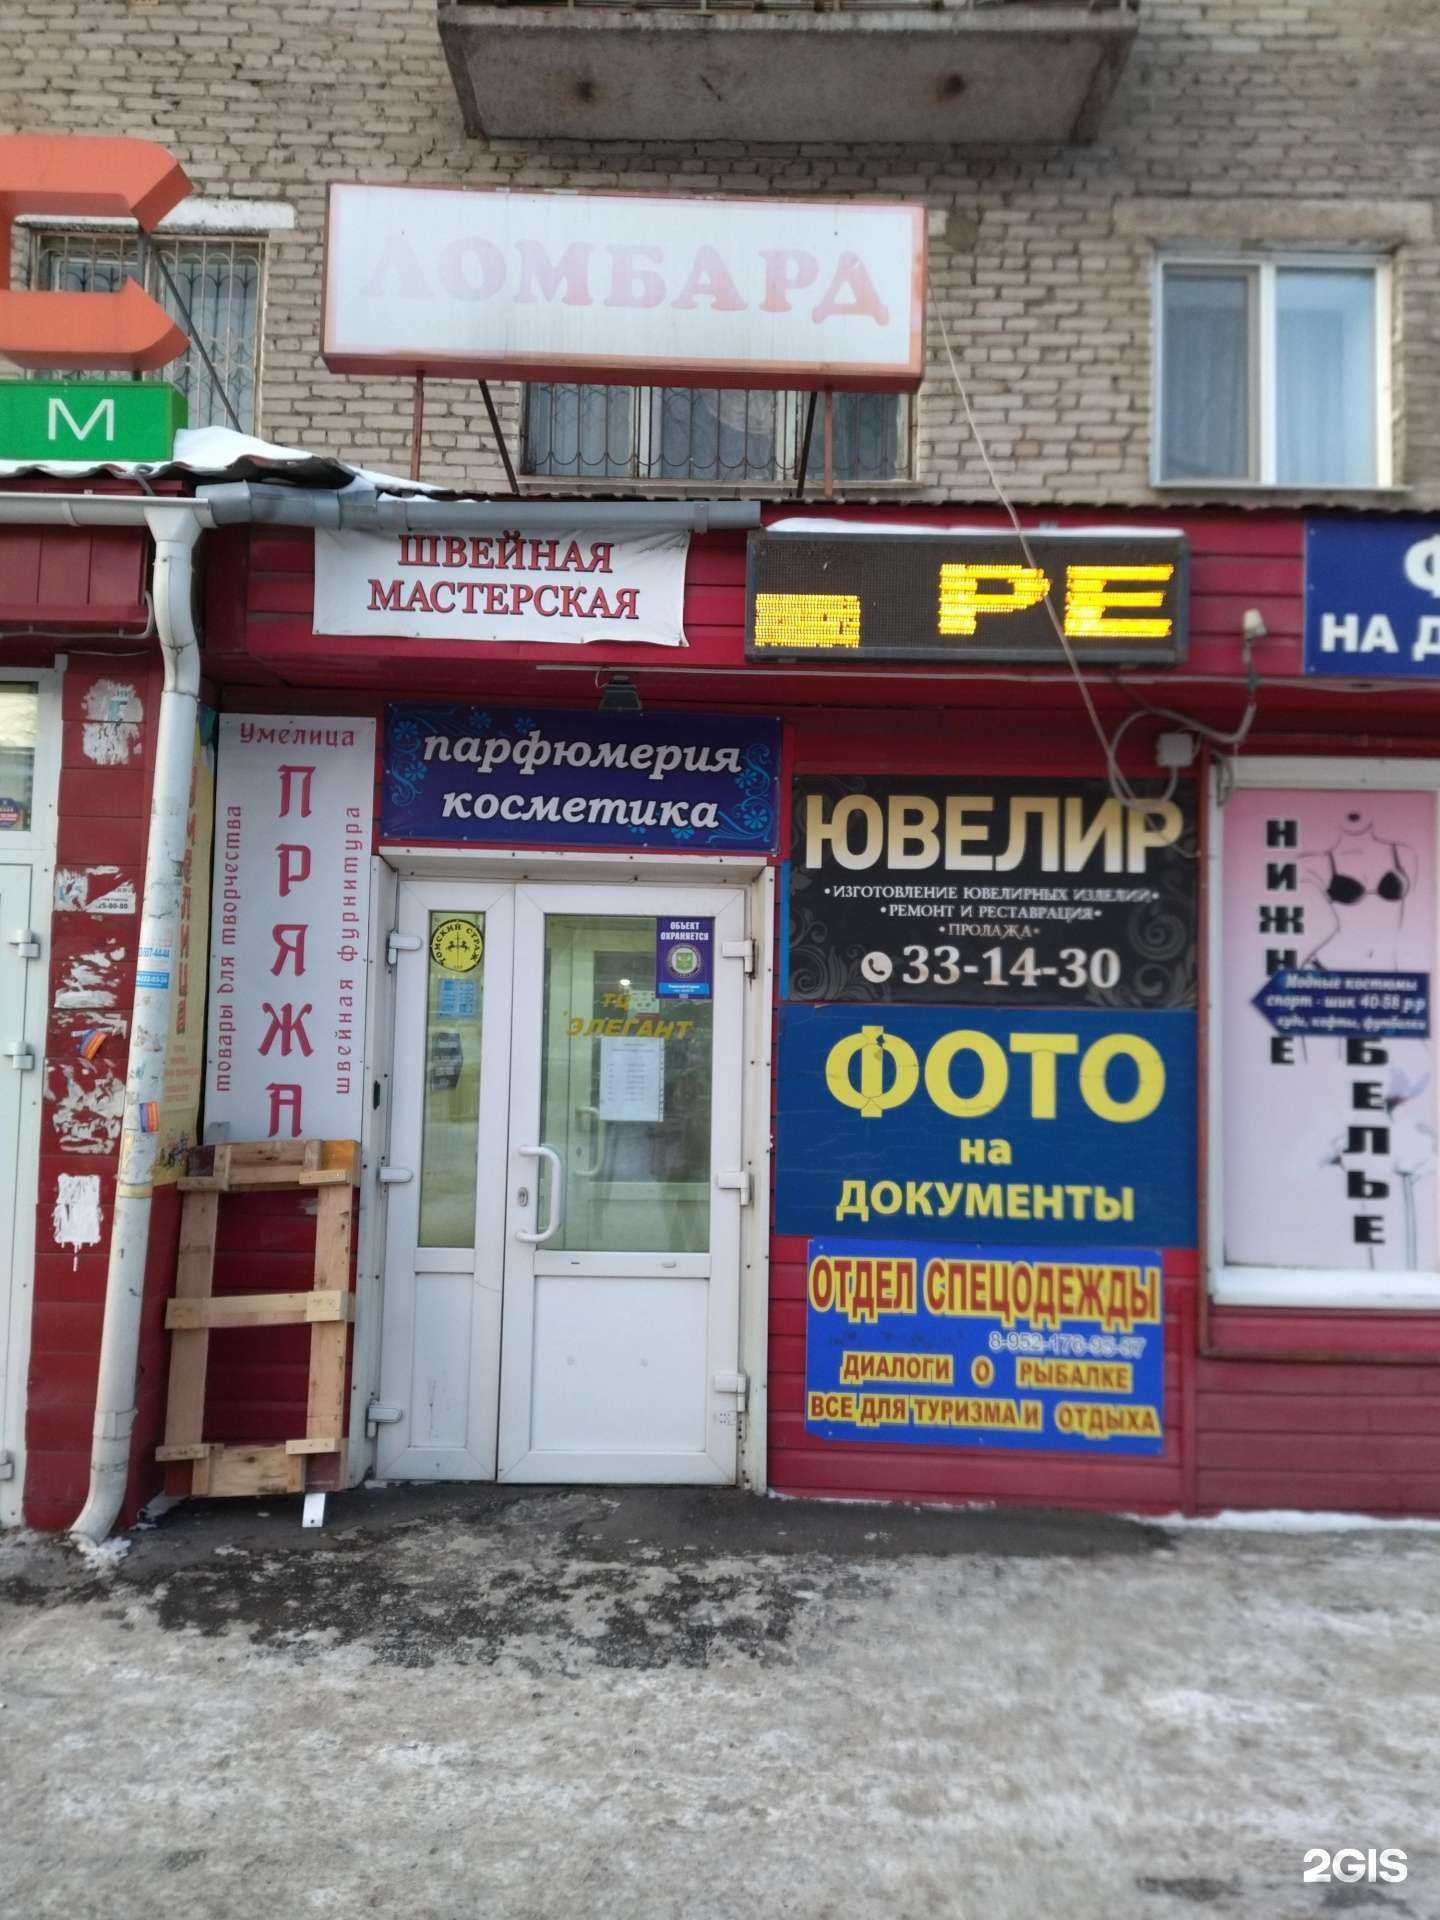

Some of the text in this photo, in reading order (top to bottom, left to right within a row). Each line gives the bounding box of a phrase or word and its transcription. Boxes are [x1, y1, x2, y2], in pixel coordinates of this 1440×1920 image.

[359, 234, 891, 327] ЛОМБАРД
[397, 529, 614, 573] ШВЕЙНАЯ
[367, 579, 640, 620] МАСТЕРСКАЯ
[1320, 612, 1399, 653] НА
[240, 722, 355, 749] Умелица
[423, 729, 743, 780] парфюмерия
[441, 791, 720, 829] косметика
[804, 793, 1184, 874] ЮВЕЛИР
[833, 885, 957, 900] ИЗГОТОВЛЕНИЕ
[963, 887, 1068, 902] ЮВЕЛИРНЫХ
[888, 904, 953, 918] РЕМОНТ
[960, 906, 973, 918] И
[216, 805, 242, 1092] товары для творчества
[258, 764, 317, 1138] ПРЯЖА
[335, 807, 363, 1094] швейная фурнитура
[1259, 819, 1304, 1065] НИЖНЕ
[902, 945, 1121, 988] 33-14-30
[566, 1016, 694, 1041] ЭЛЕГАНТ
[825, 1025, 1166, 1123] ФОТО
[960, 1138, 1012, 1165] на
[1345, 1037, 1391, 1244] БЕЛЬЕ
[836, 1180, 1135, 1222] ДОКУМЕНТЫ
[809, 1256, 1162, 1334] ОТДЕЛ СПЕЦОДЕЖДЫ
[840, 1351, 1134, 1393] ДИАЛОГИ О РЫБАЛКЕ
[808, 1391, 855, 1420] ВСЕ
[856, 1393, 909, 1427] ДЛЯ
[913, 1394, 1017, 1429] ТУРИЗМА
[1055, 1401, 1162, 1440] ОТДЫХА
